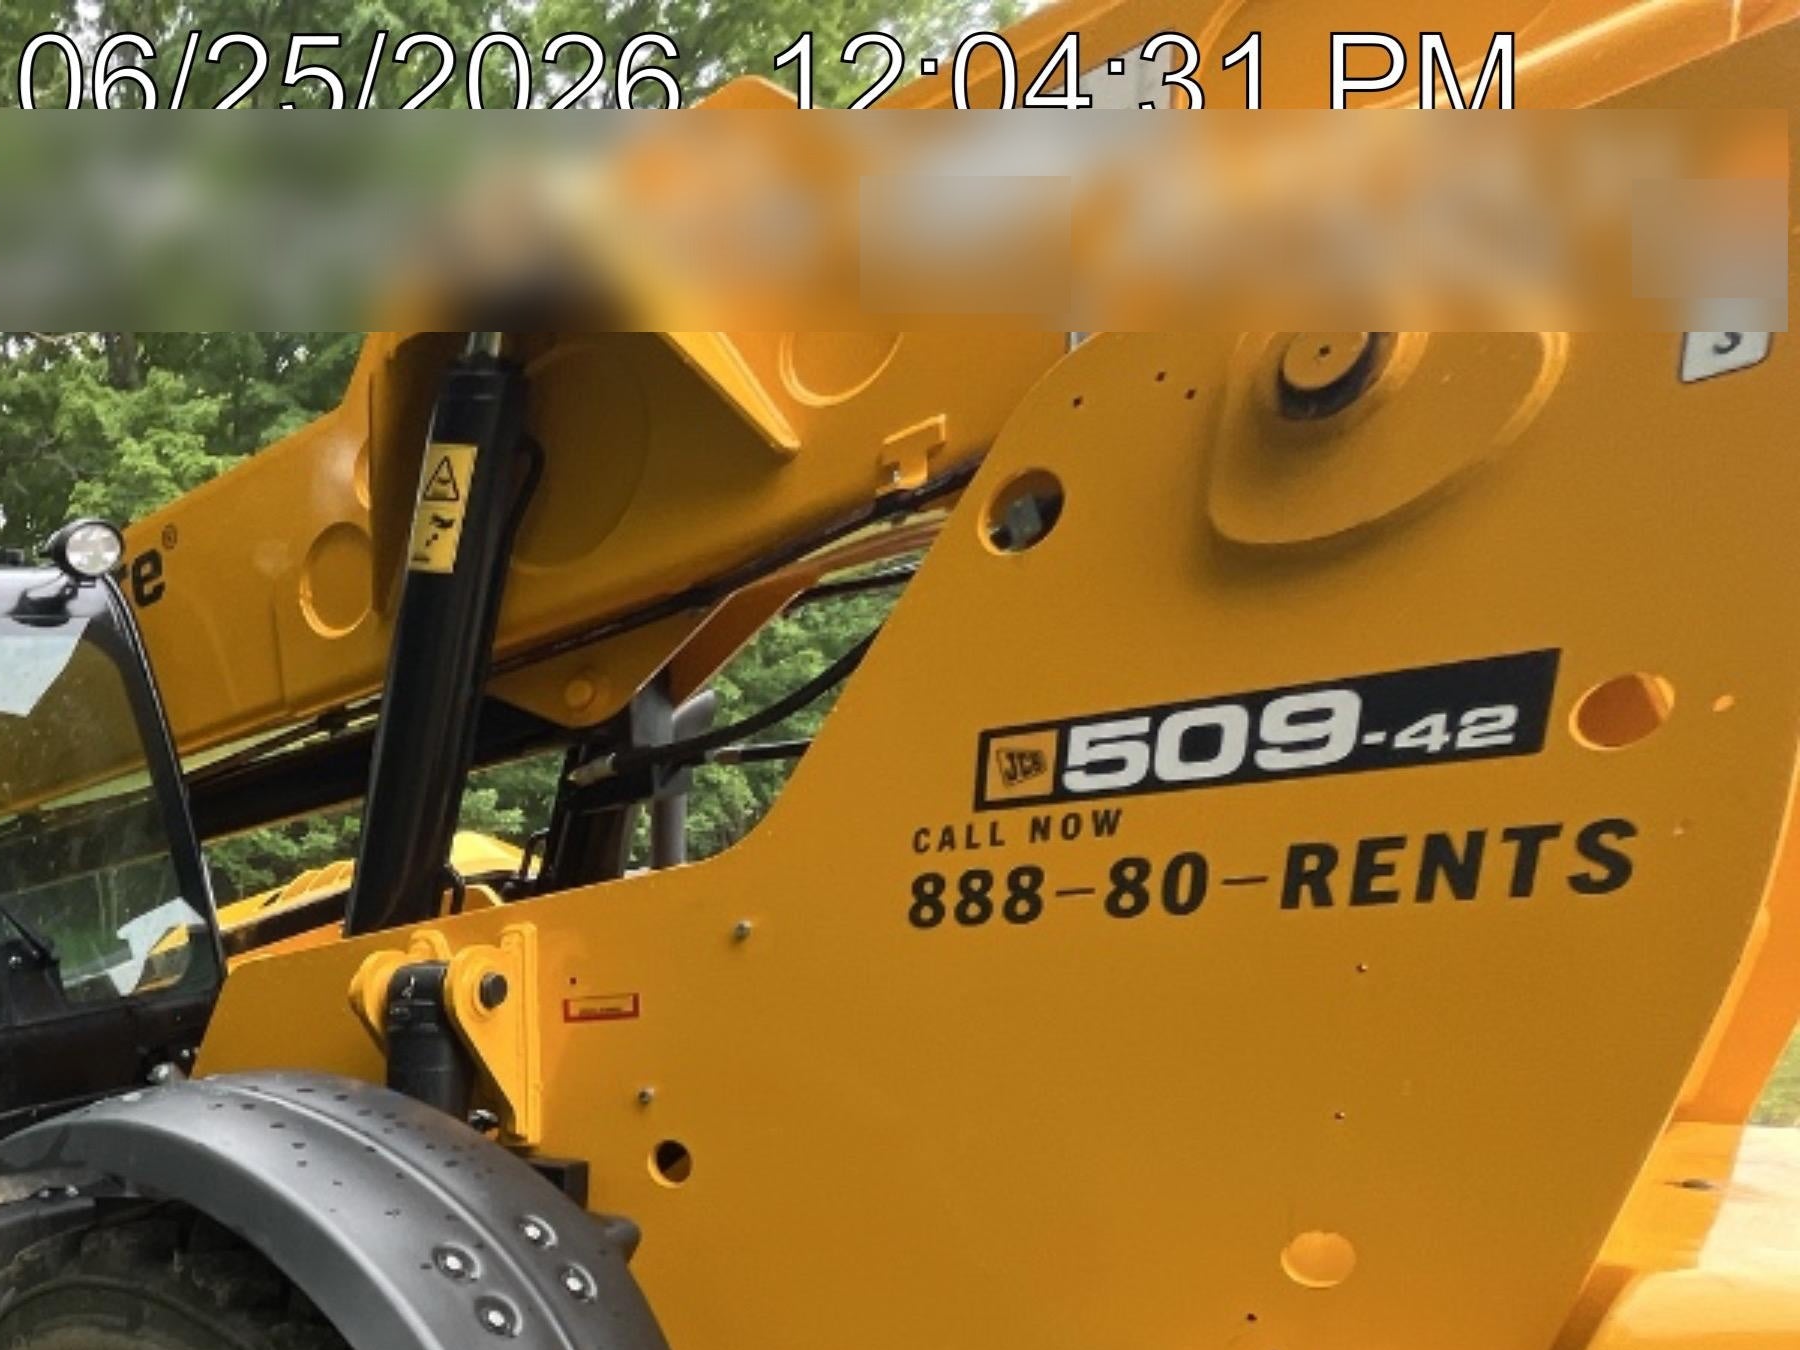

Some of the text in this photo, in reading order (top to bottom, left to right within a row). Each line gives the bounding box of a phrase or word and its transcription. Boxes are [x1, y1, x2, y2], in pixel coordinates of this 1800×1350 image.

[1062, 689, 1520, 793] 509-42
[907, 818, 1639, 930] 888-80-RENTS
[911, 808, 1124, 855] CALL NOW
